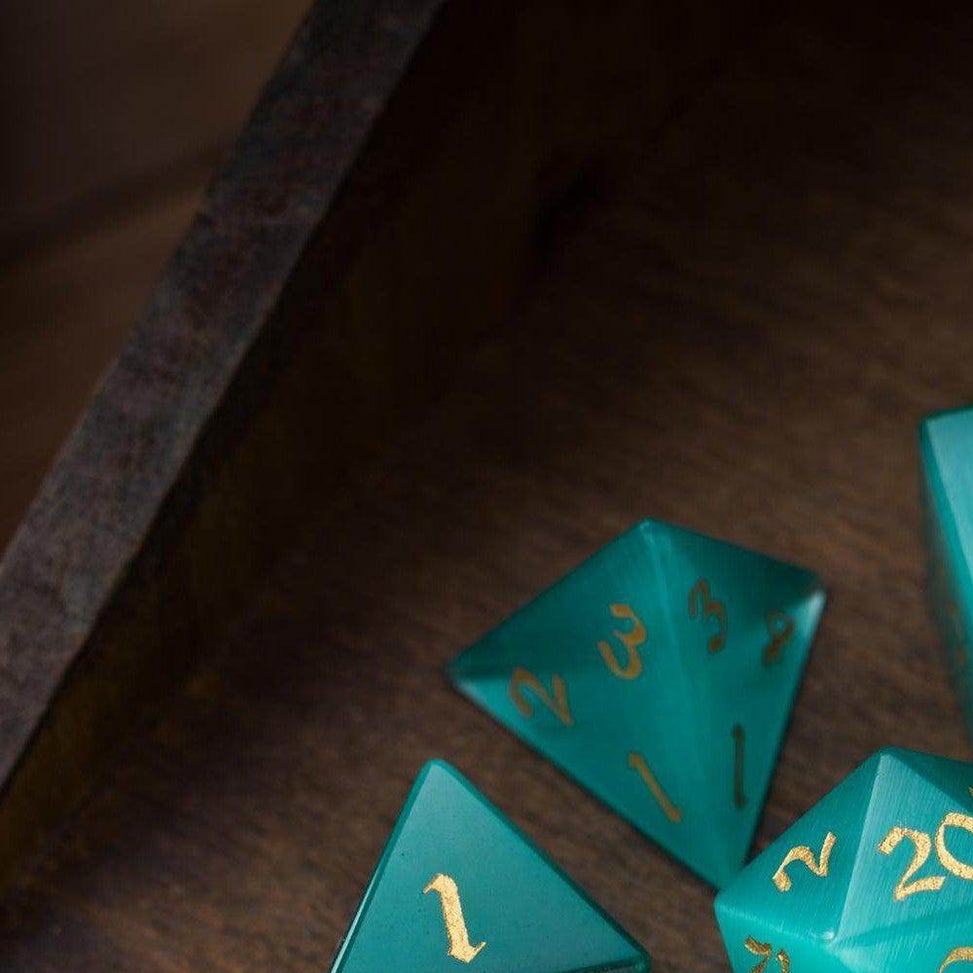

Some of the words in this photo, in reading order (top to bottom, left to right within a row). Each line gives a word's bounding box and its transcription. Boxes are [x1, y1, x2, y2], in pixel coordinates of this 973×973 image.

[599, 604, 646, 679] 3
[689, 578, 728, 654] 3
[508, 667, 573, 726] 2
[628, 750, 681, 823] 1
[772, 832, 837, 892] 2
[422, 873, 487, 964] 1
